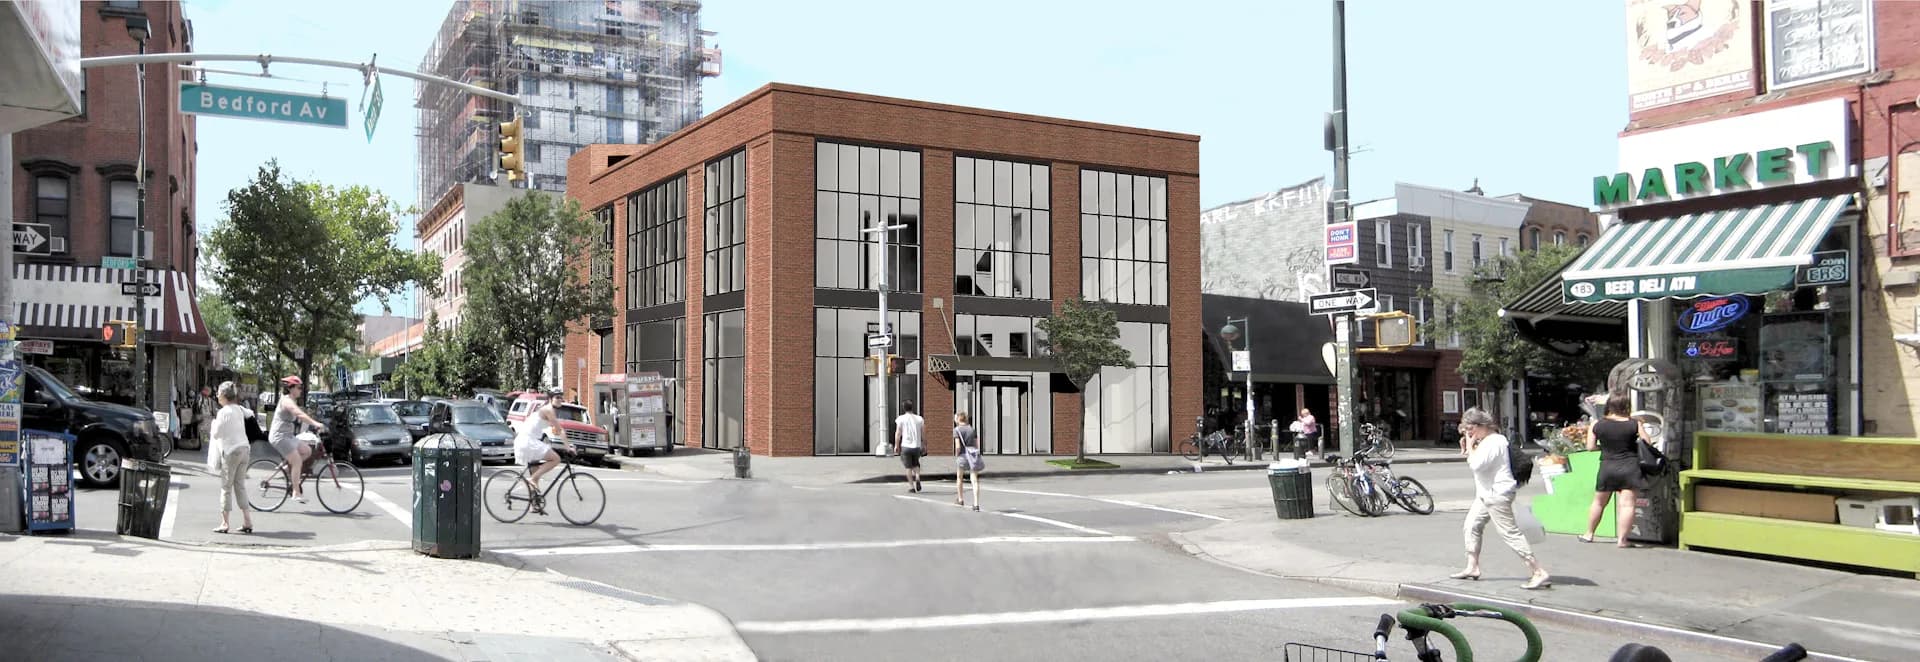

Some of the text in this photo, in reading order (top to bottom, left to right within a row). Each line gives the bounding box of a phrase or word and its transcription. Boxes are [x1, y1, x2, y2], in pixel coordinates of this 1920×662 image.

[201, 92, 328, 119] Bedford Av
[1593, 141, 1836, 206] MARKET
[1575, 276, 1697, 295] 183 BEER DELI ATM
[1318, 295, 1366, 307] ONE WAY
